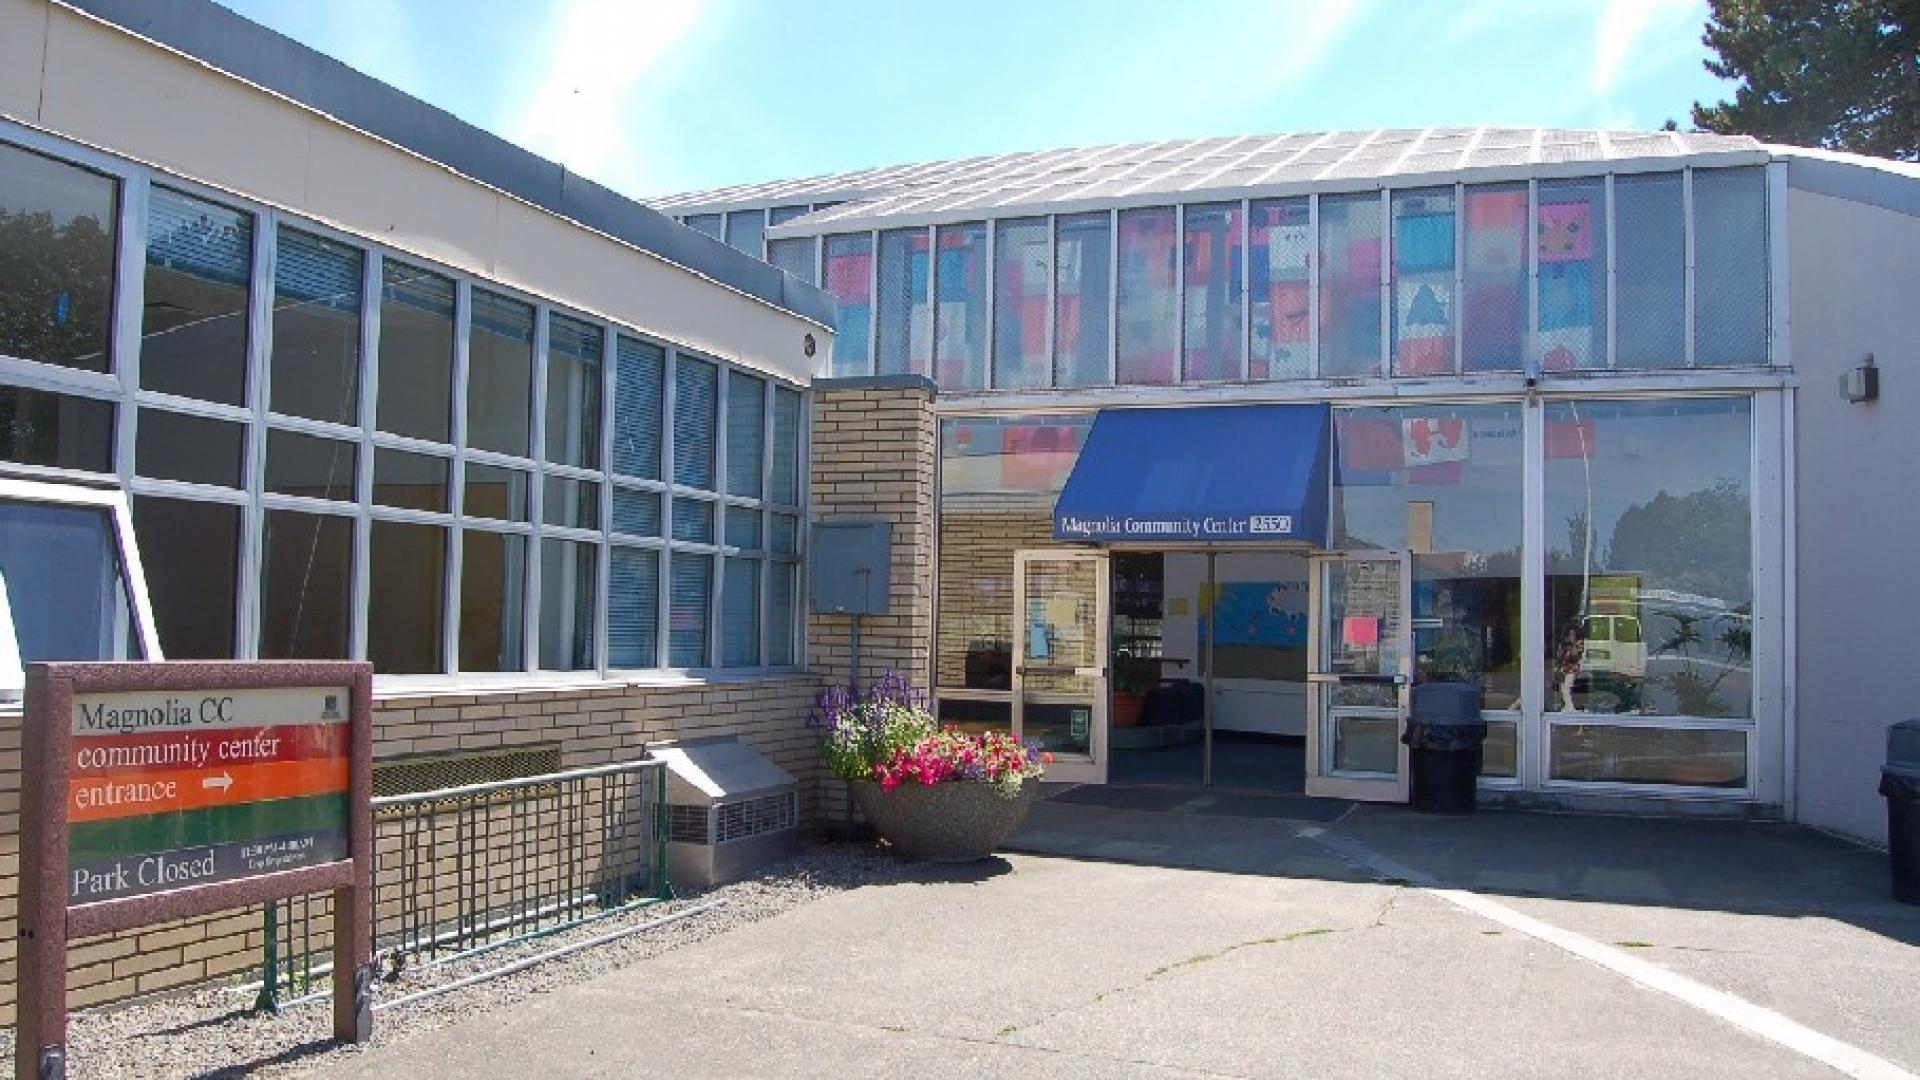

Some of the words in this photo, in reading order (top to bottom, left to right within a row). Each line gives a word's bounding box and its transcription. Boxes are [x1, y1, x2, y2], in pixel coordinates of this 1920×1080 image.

[1061, 516, 1121, 537] Magnolia
[1125, 517, 1200, 537] Community
[1203, 516, 1247, 534] Center
[1252, 516, 1290, 533] 2550
[79, 699, 192, 734] Magnolia
[200, 697, 233, 724] CC
[77, 734, 210, 768] community
[219, 732, 281, 760] center
[75, 780, 176, 809] entrance
[72, 863, 129, 897] Park
[138, 849, 214, 886] Closed
